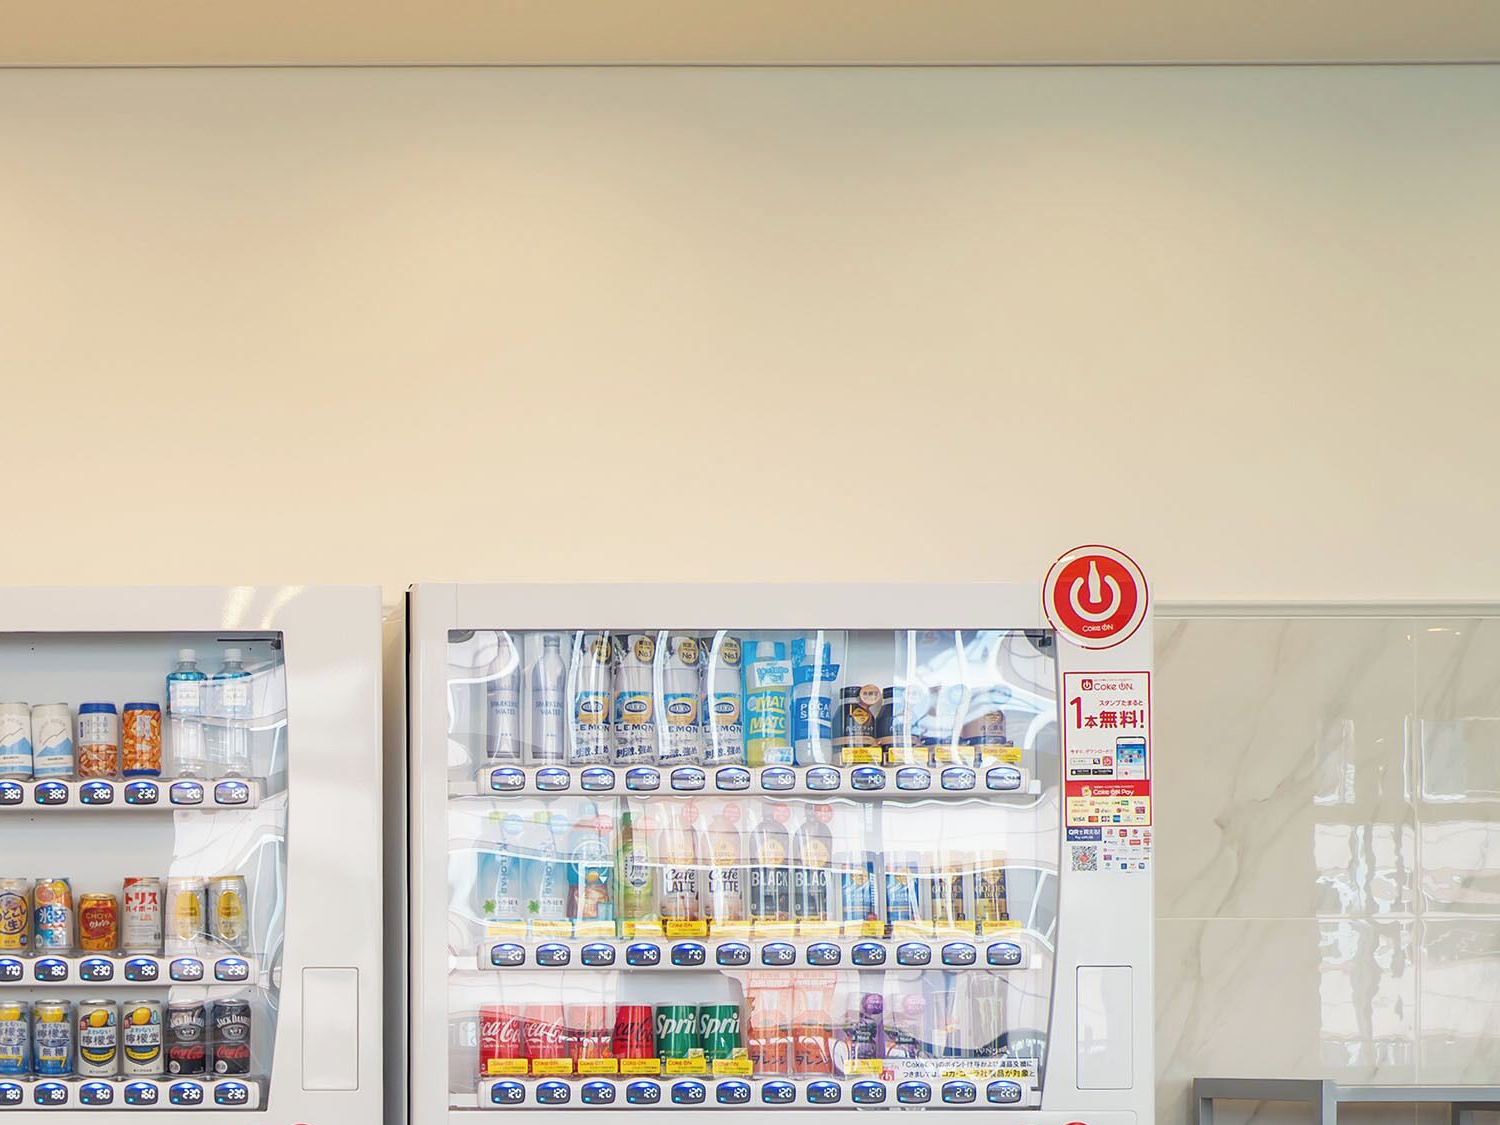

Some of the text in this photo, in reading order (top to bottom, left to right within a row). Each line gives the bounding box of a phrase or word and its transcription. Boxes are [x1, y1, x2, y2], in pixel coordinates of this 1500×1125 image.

[1101, 623, 1114, 632] ON
[1118, 682, 1133, 691] ON
[1099, 699, 1144, 707] スタンプたまると
[1070, 696, 1145, 729] 1本無料!
[4, 788, 21, 800] 380
[49, 788, 66, 800] 380
[93, 788, 111, 800] 280
[137, 788, 156, 800] 230
[1121, 788, 1135, 797] Pay
[665, 868, 696, 881] Café
[751, 870, 788, 888] BLACK
[125, 892, 158, 905] トリス
[125, 905, 158, 913] ハイボール
[85, 912, 114, 920] CHOYA
[92, 965, 111, 976] 230
[182, 965, 200, 976] 230
[227, 965, 246, 976] 230
[182, 1089, 200, 1100] 230
[227, 1089, 245, 1100] 230
[508, 1088, 522, 1099] 120
[553, 1088, 567, 1099] 120
[598, 1088, 613, 1099] 120
[643, 1088, 658, 1099] 120
[688, 1088, 703, 1099] 120
[733, 1088, 747, 1099] 120
[778, 1088, 793, 1099] 120
[823, 1088, 838, 1099] 120
[868, 1088, 883, 1099] 120
[913, 1088, 928, 1099] 120
